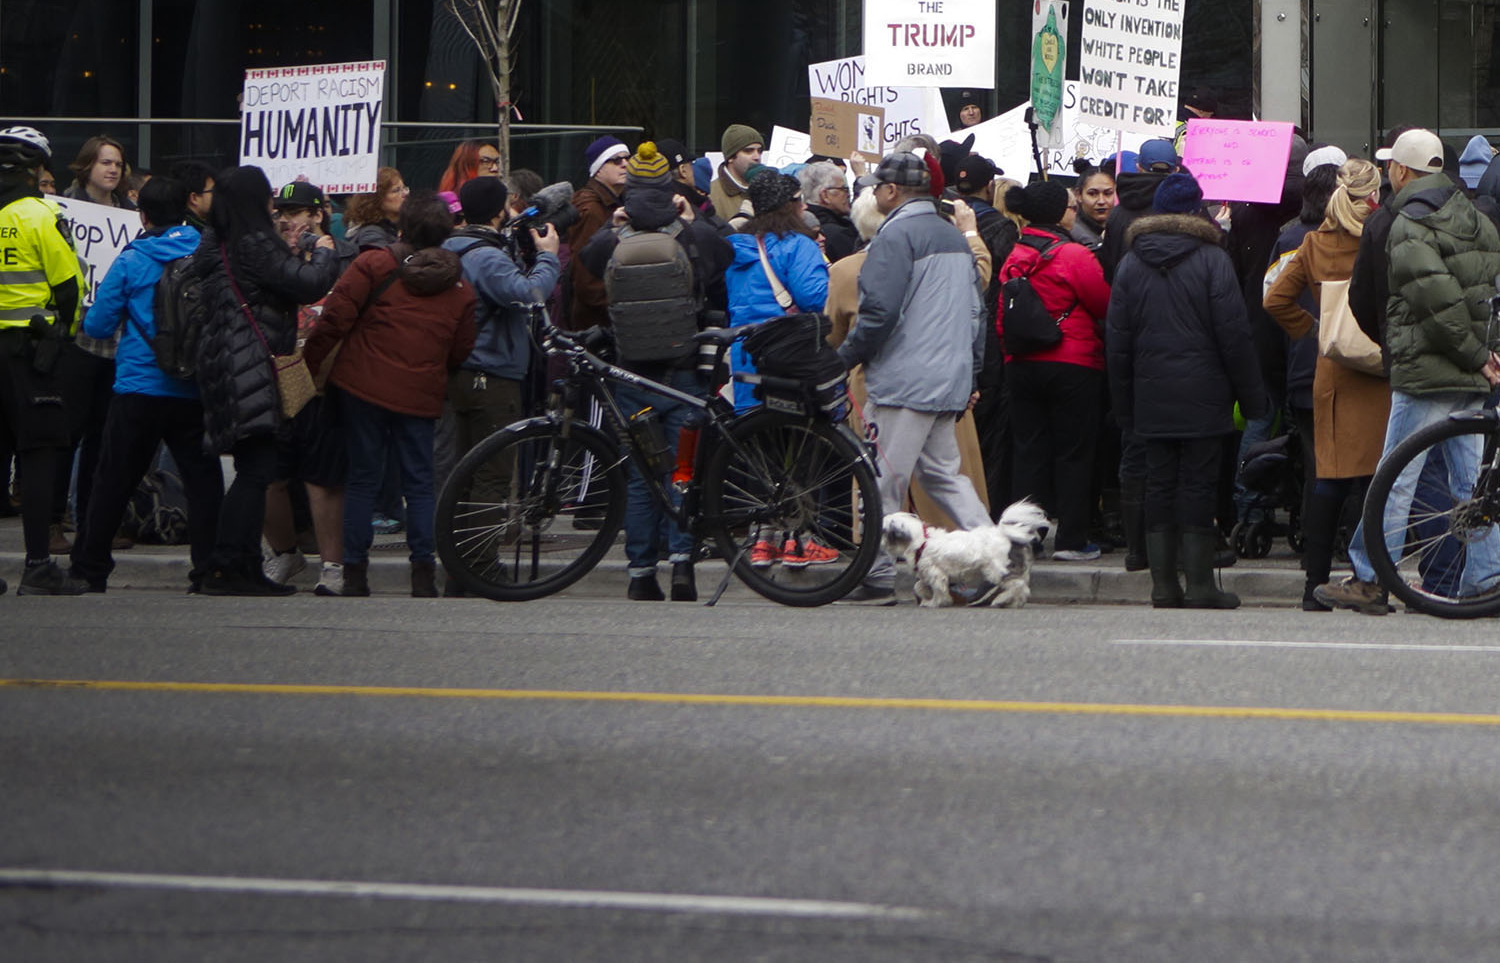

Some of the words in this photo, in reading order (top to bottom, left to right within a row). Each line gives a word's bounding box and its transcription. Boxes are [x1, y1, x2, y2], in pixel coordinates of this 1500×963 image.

[918, 1, 944, 13] THE
[887, 24, 976, 47] TRUMP
[1085, 7, 1116, 29] ONLY
[1120, 14, 1181, 40] INVENTION
[1083, 37, 1124, 61] WHITE
[1128, 46, 1177, 69] PEOPLE
[907, 63, 953, 75] BRAND
[1082, 66, 1127, 91] WON'T
[1134, 76, 1177, 98] TAKE
[247, 82, 310, 107] DEPORT
[318, 77, 380, 99] RACISM
[1080, 96, 1129, 120] CREDIT
[1132, 106, 1172, 126] FOR!
[243, 100, 382, 159] HUMANITY
[883, 118, 921, 143] GHTS
